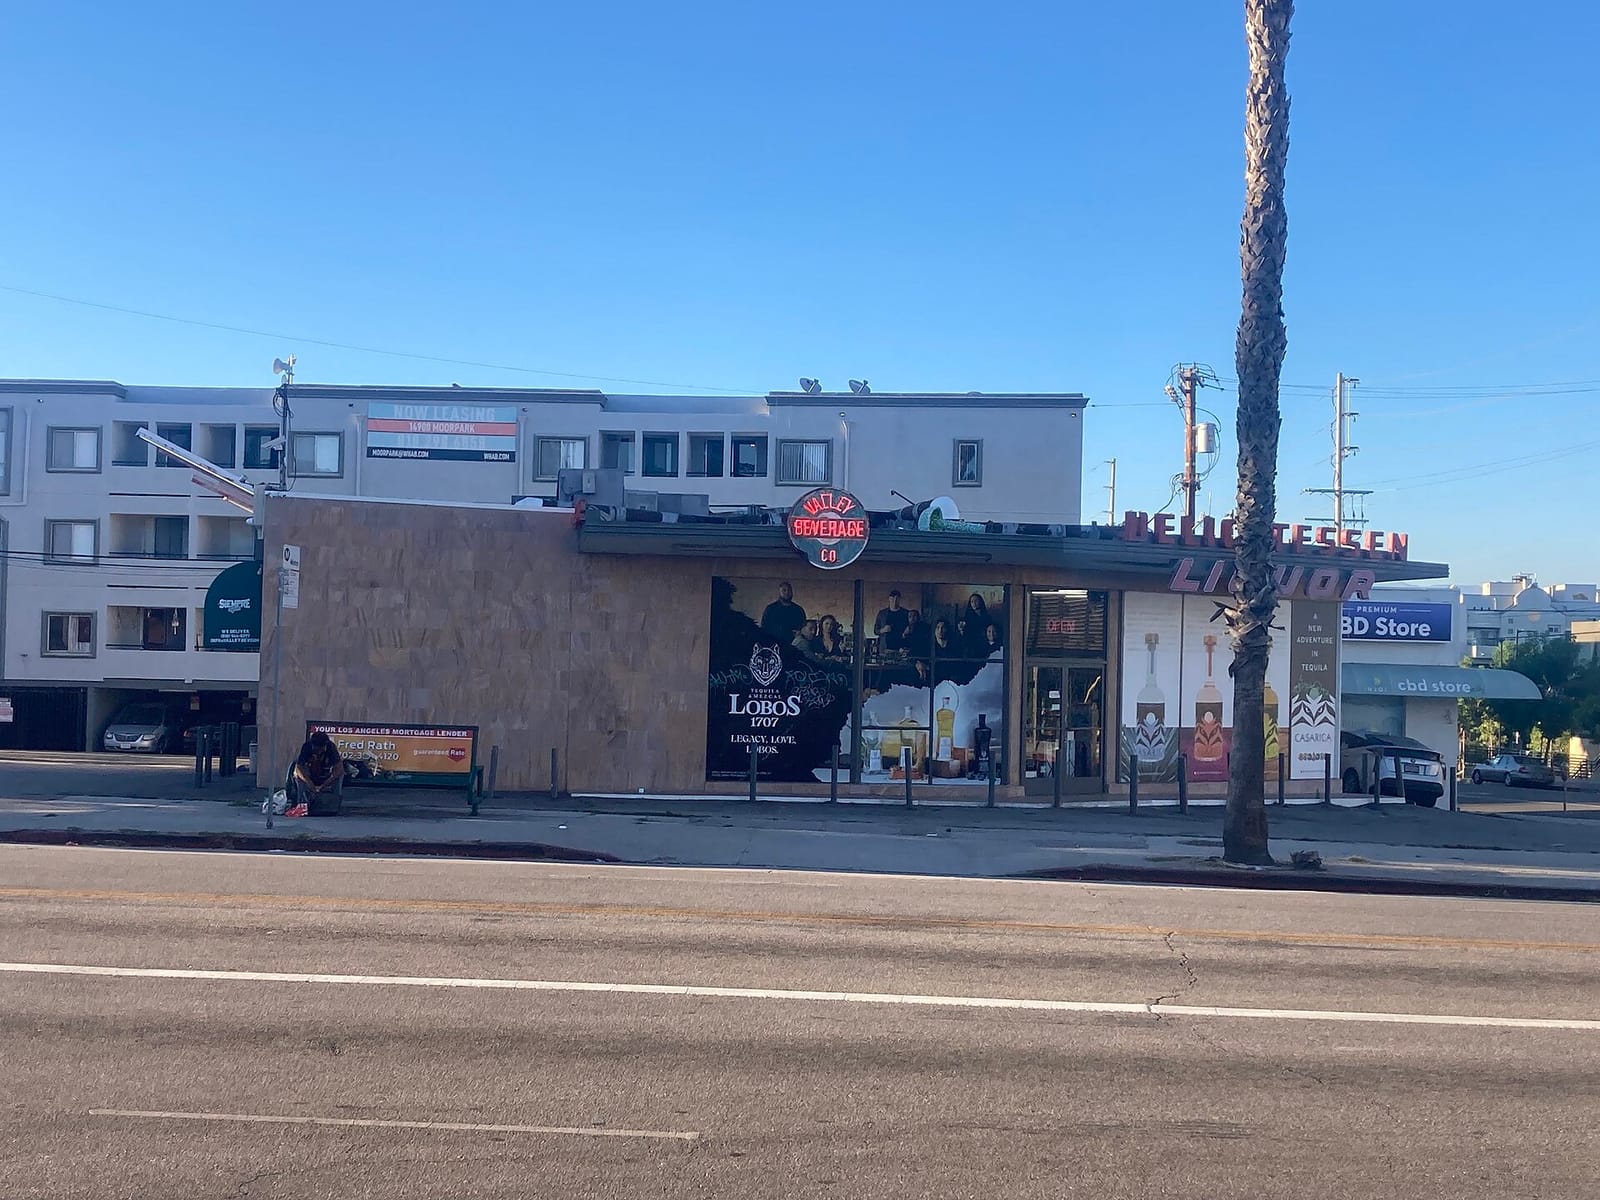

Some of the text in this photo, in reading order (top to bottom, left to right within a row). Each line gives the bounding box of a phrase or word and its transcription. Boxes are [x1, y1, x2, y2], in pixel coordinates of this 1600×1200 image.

[394, 405, 496, 421] NOW LEASING
[432, 423, 475, 433] MOORPARK
[803, 493, 857, 515] VALLEY
[794, 519, 865, 537] BEVERAGE
[1125, 510, 1409, 561] DELICTESSEN
[218, 598, 251, 609] SIEMPRE
[1356, 606, 1398, 614] PREMIUM
[1375, 617, 1432, 637] Store
[1296, 636, 1334, 645] ADVENTURE
[1301, 663, 1328, 672] TEQUILA
[1397, 678, 1472, 693] cbd store
[728, 693, 802, 717] LOBOS
[750, 717, 779, 728] 1707
[355, 727, 391, 735] ANGELES
[730, 734, 797, 744] LEGACY, LOVE,
[337, 739, 396, 751] Fred Rath
[746, 745, 779, 754] LBOS.
